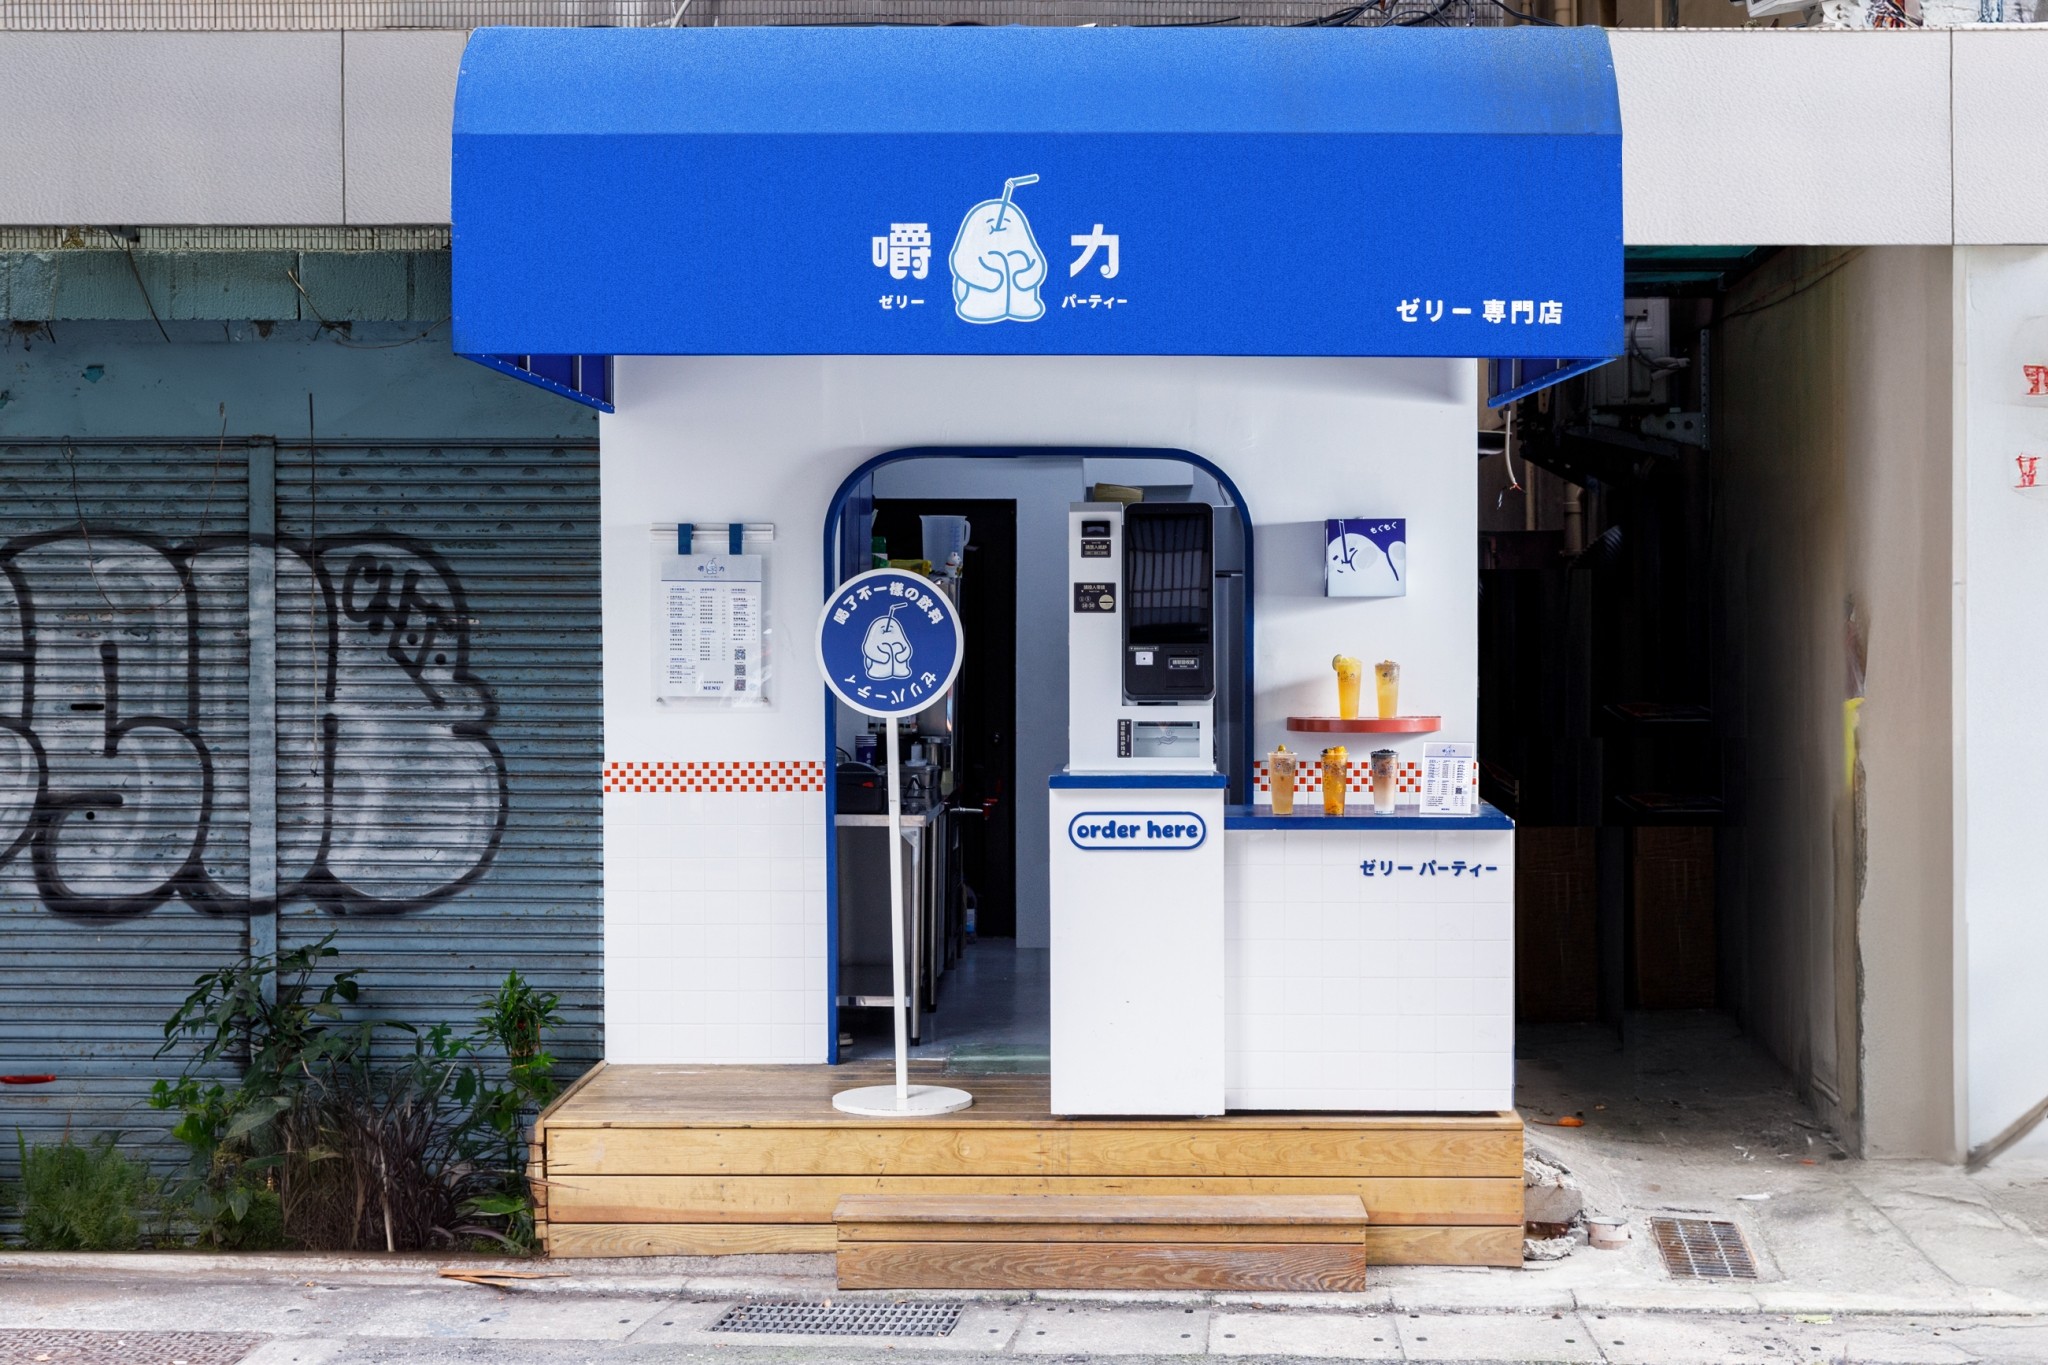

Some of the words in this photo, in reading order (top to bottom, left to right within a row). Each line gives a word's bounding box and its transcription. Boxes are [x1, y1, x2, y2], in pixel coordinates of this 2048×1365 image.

[872, 223, 931, 280] 嚼
[1070, 223, 1119, 279] 力
[879, 294, 924, 309] ゼリー
[1062, 294, 1127, 309] パーティー
[1077, 820, 1141, 839] order
[1147, 820, 1198, 839] here
